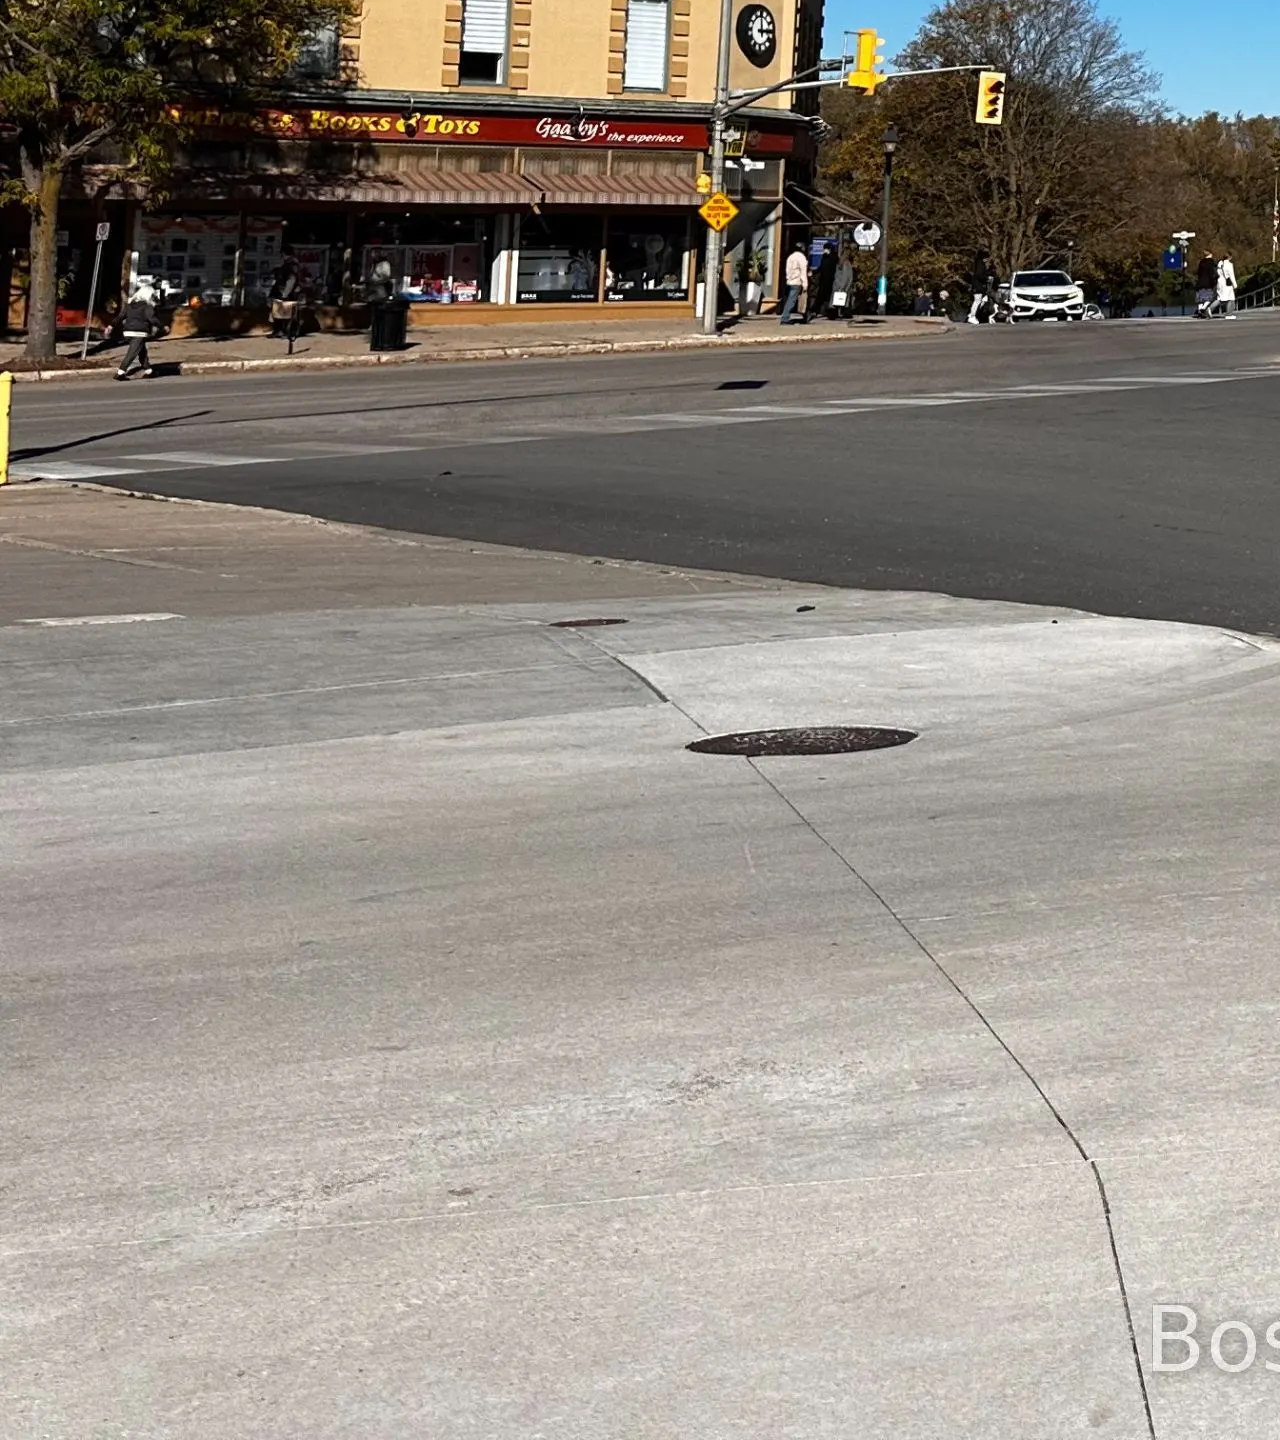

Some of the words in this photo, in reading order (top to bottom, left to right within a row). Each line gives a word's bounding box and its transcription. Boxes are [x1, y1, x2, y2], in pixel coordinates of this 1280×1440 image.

[309, 110, 392, 132] BOOKS
[423, 114, 481, 135] TOYS
[606, 132, 623, 142] the
[627, 133, 685, 144] experience
